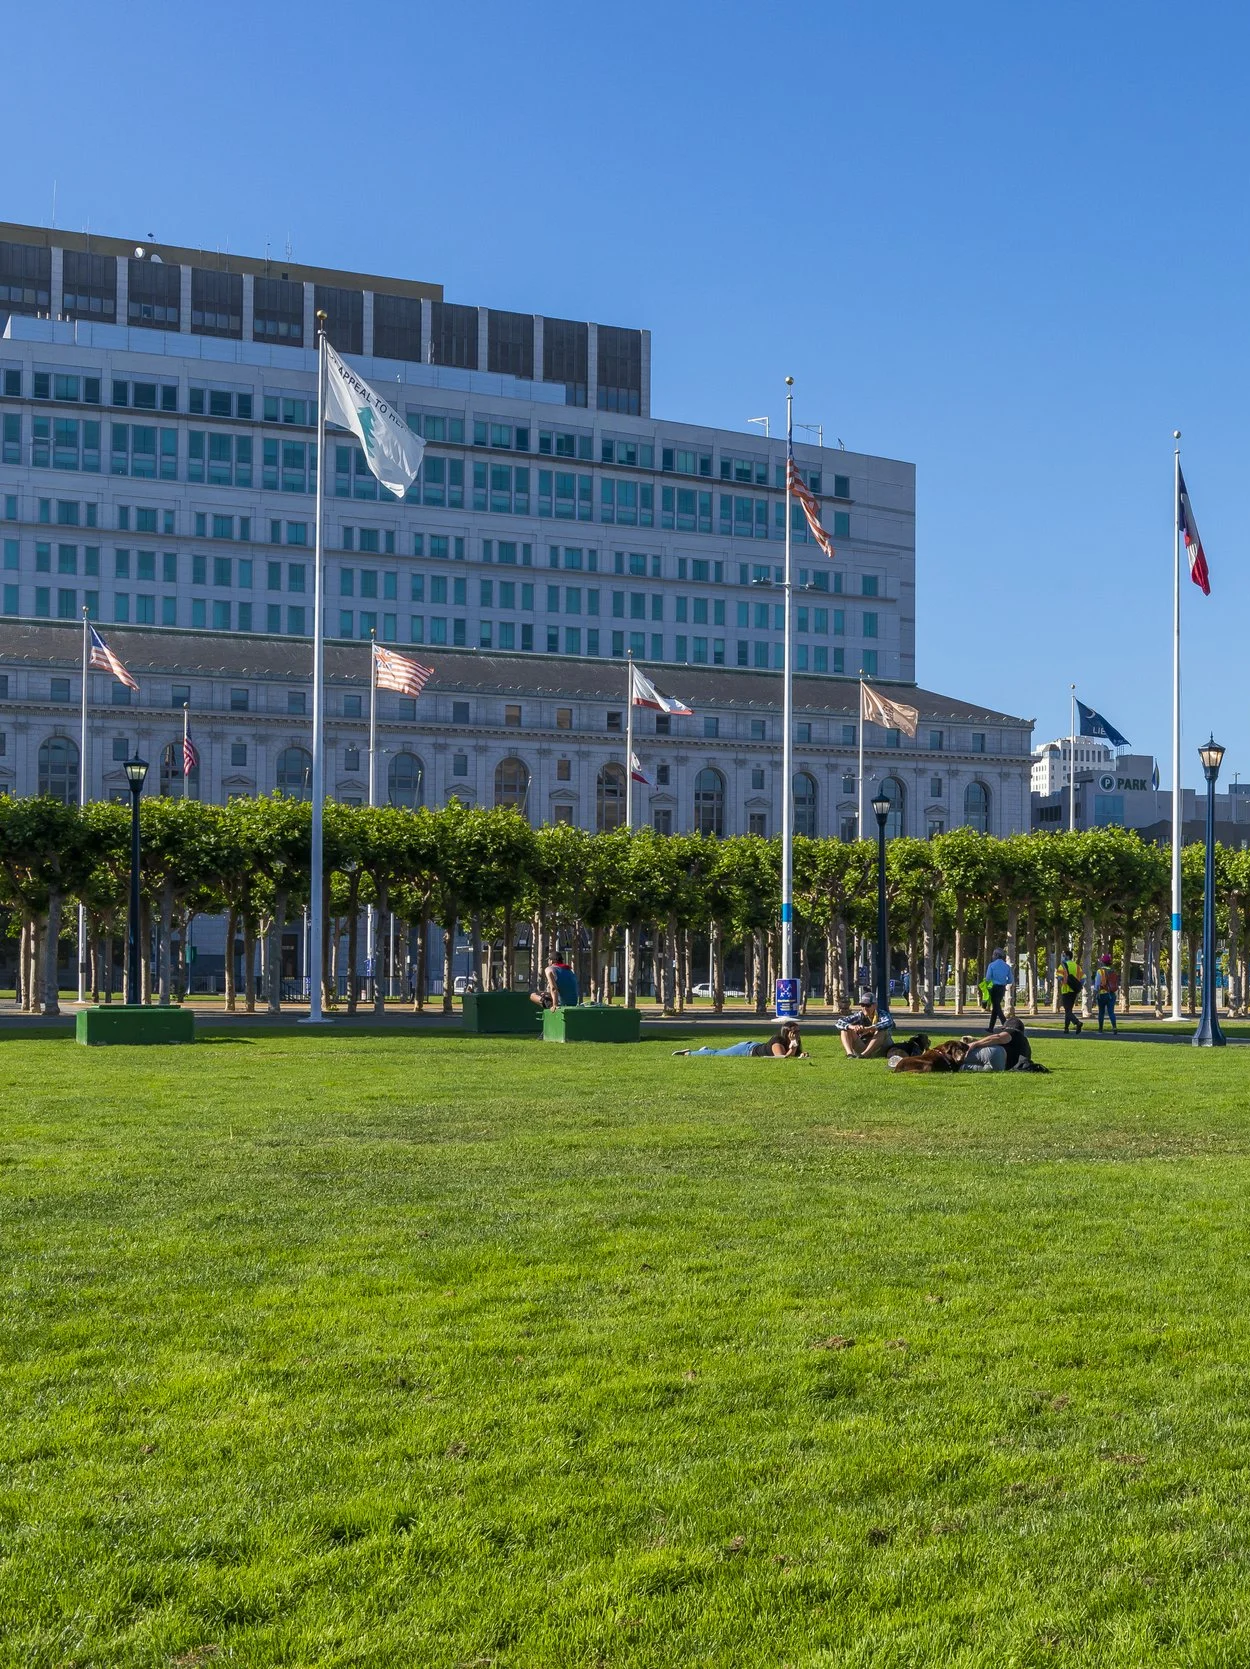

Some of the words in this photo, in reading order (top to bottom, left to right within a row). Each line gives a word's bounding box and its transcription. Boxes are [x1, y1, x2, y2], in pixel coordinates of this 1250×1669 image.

[338, 366, 372, 402] APPEAL
[374, 398, 388, 414] TO
[1117, 778, 1148, 791] PARK
